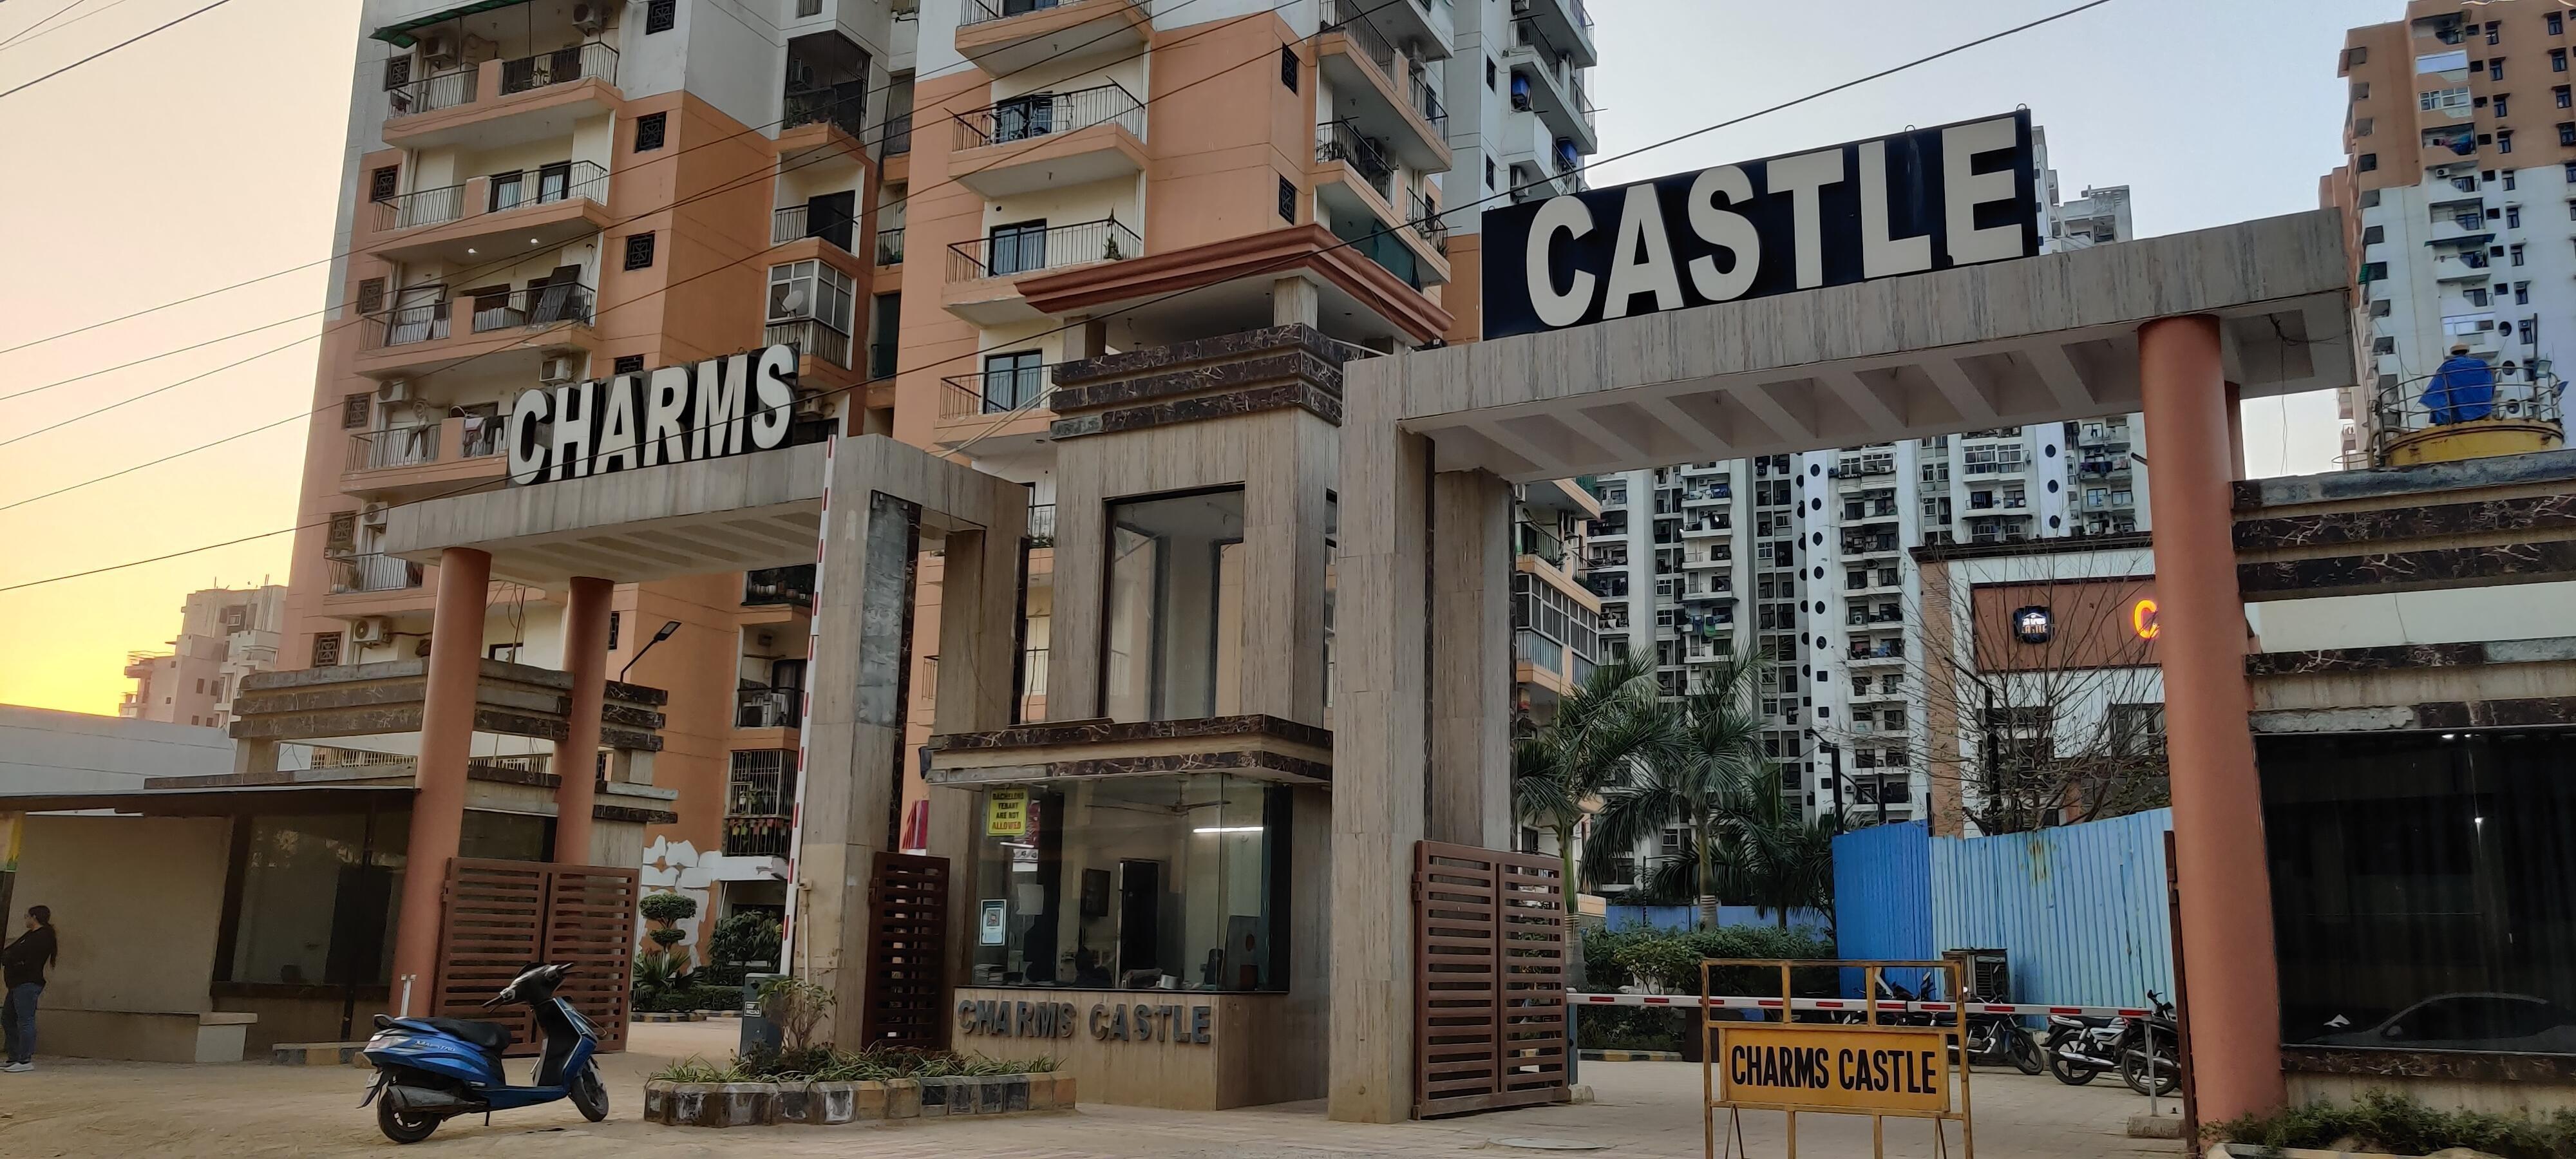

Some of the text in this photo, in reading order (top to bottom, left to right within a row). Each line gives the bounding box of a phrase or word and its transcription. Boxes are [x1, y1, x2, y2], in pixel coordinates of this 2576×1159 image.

[1526, 116, 2023, 327] CASTLE
[509, 343, 799, 485] CHARMS
[957, 999, 1211, 1044] CHARMS CASTLE
[1732, 1045, 1937, 1095] CHARMS CASTLE
